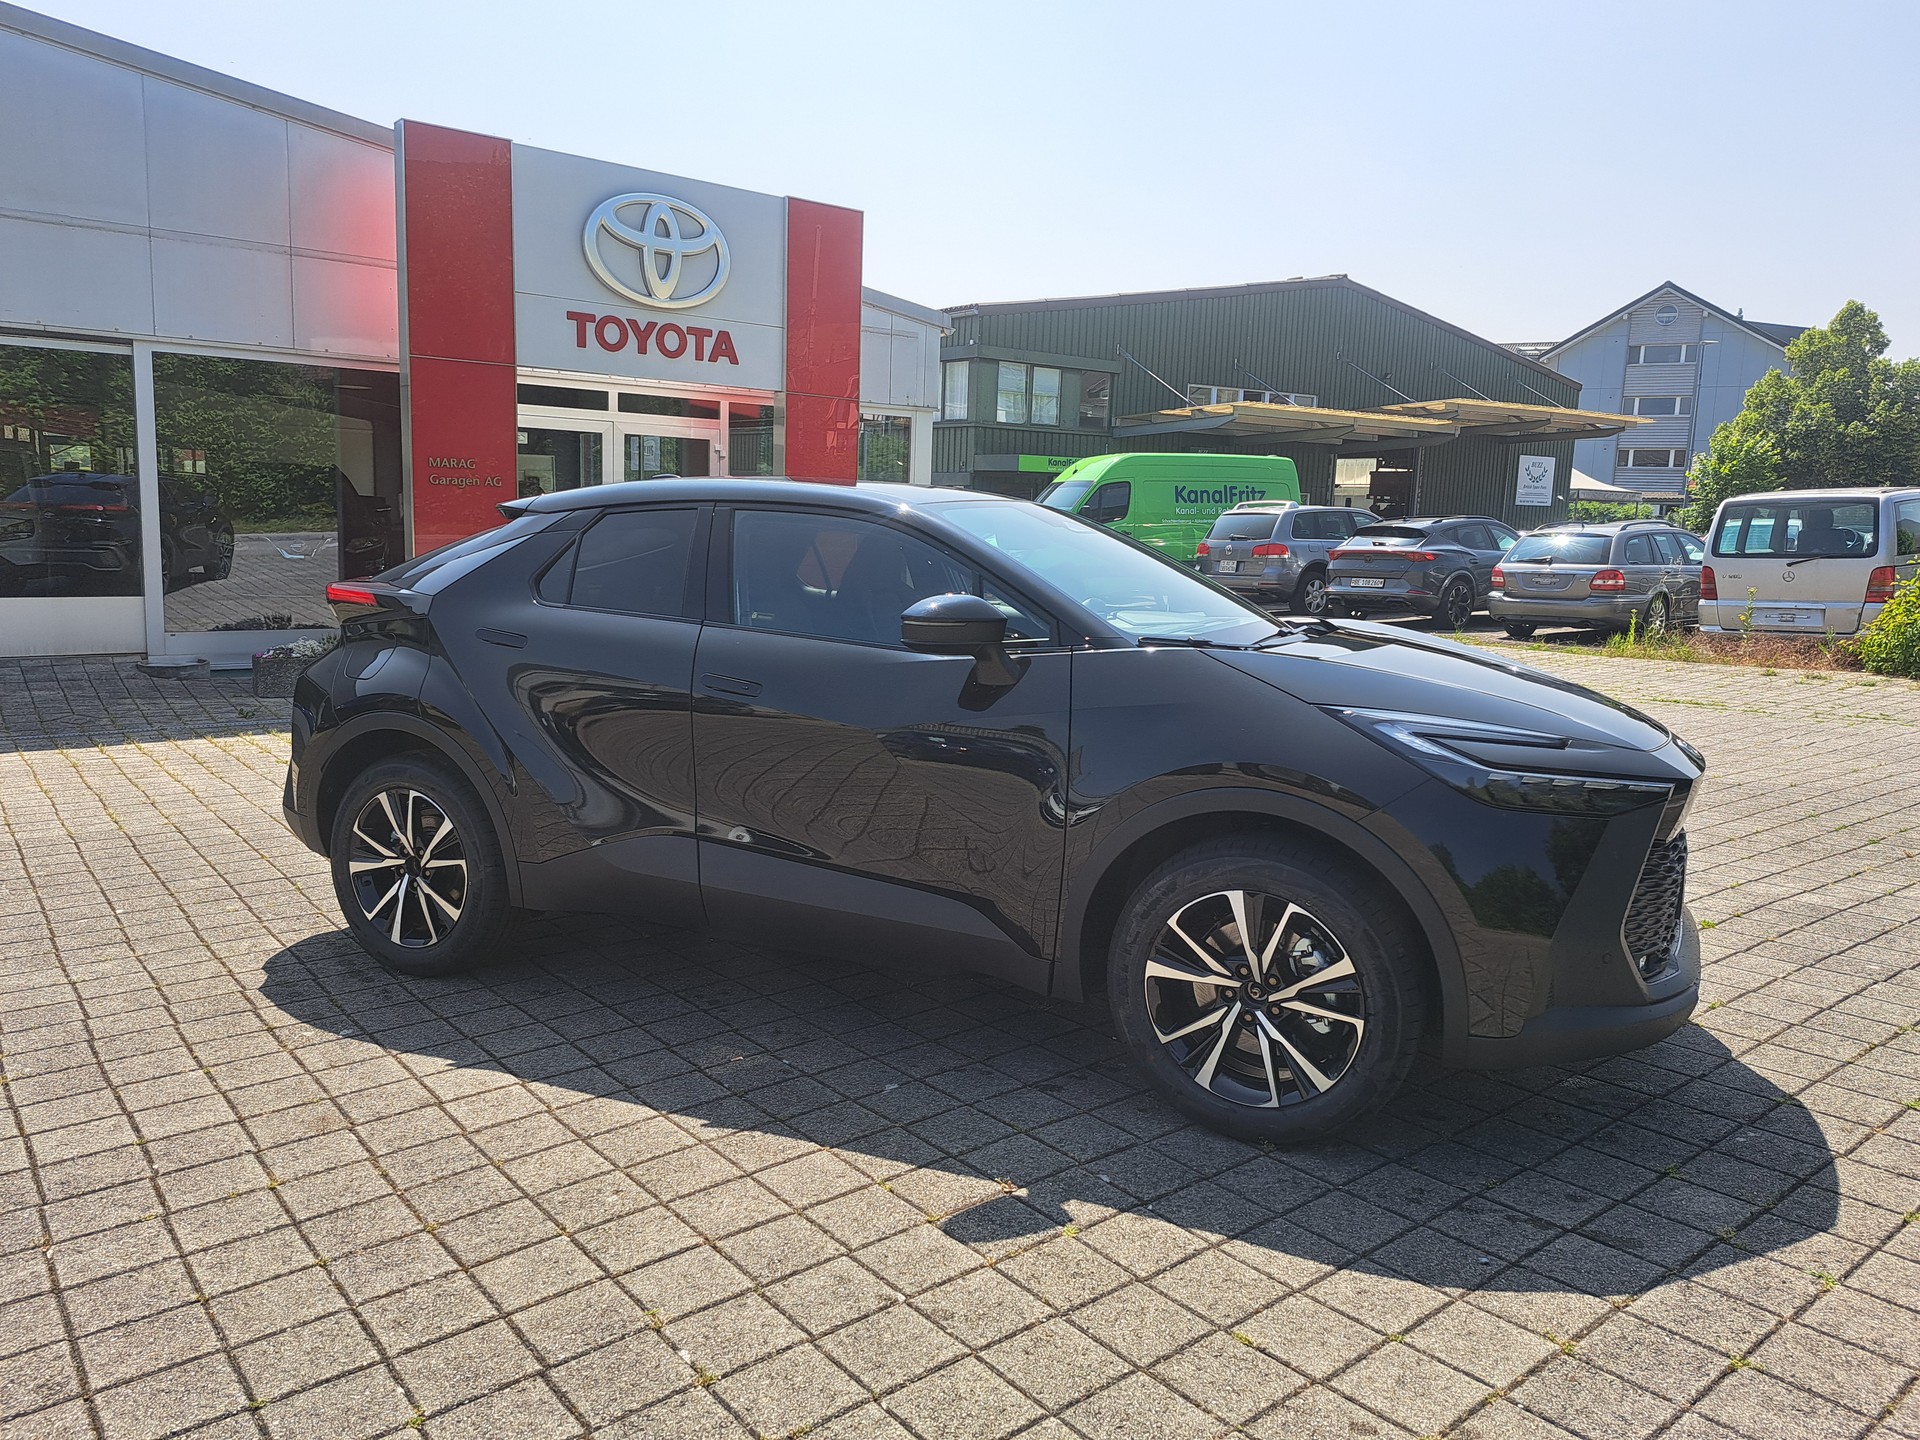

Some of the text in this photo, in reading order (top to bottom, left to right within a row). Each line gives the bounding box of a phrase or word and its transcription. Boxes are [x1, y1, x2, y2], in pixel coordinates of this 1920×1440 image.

[566, 311, 740, 366] TOYOTA
[428, 457, 476, 469] MARAG
[429, 474, 502, 488] Garagen AG
[1174, 484, 1267, 504] KanalFritz
[1175, 506, 1200, 515] Kanal-
[1201, 506, 1216, 515] und
